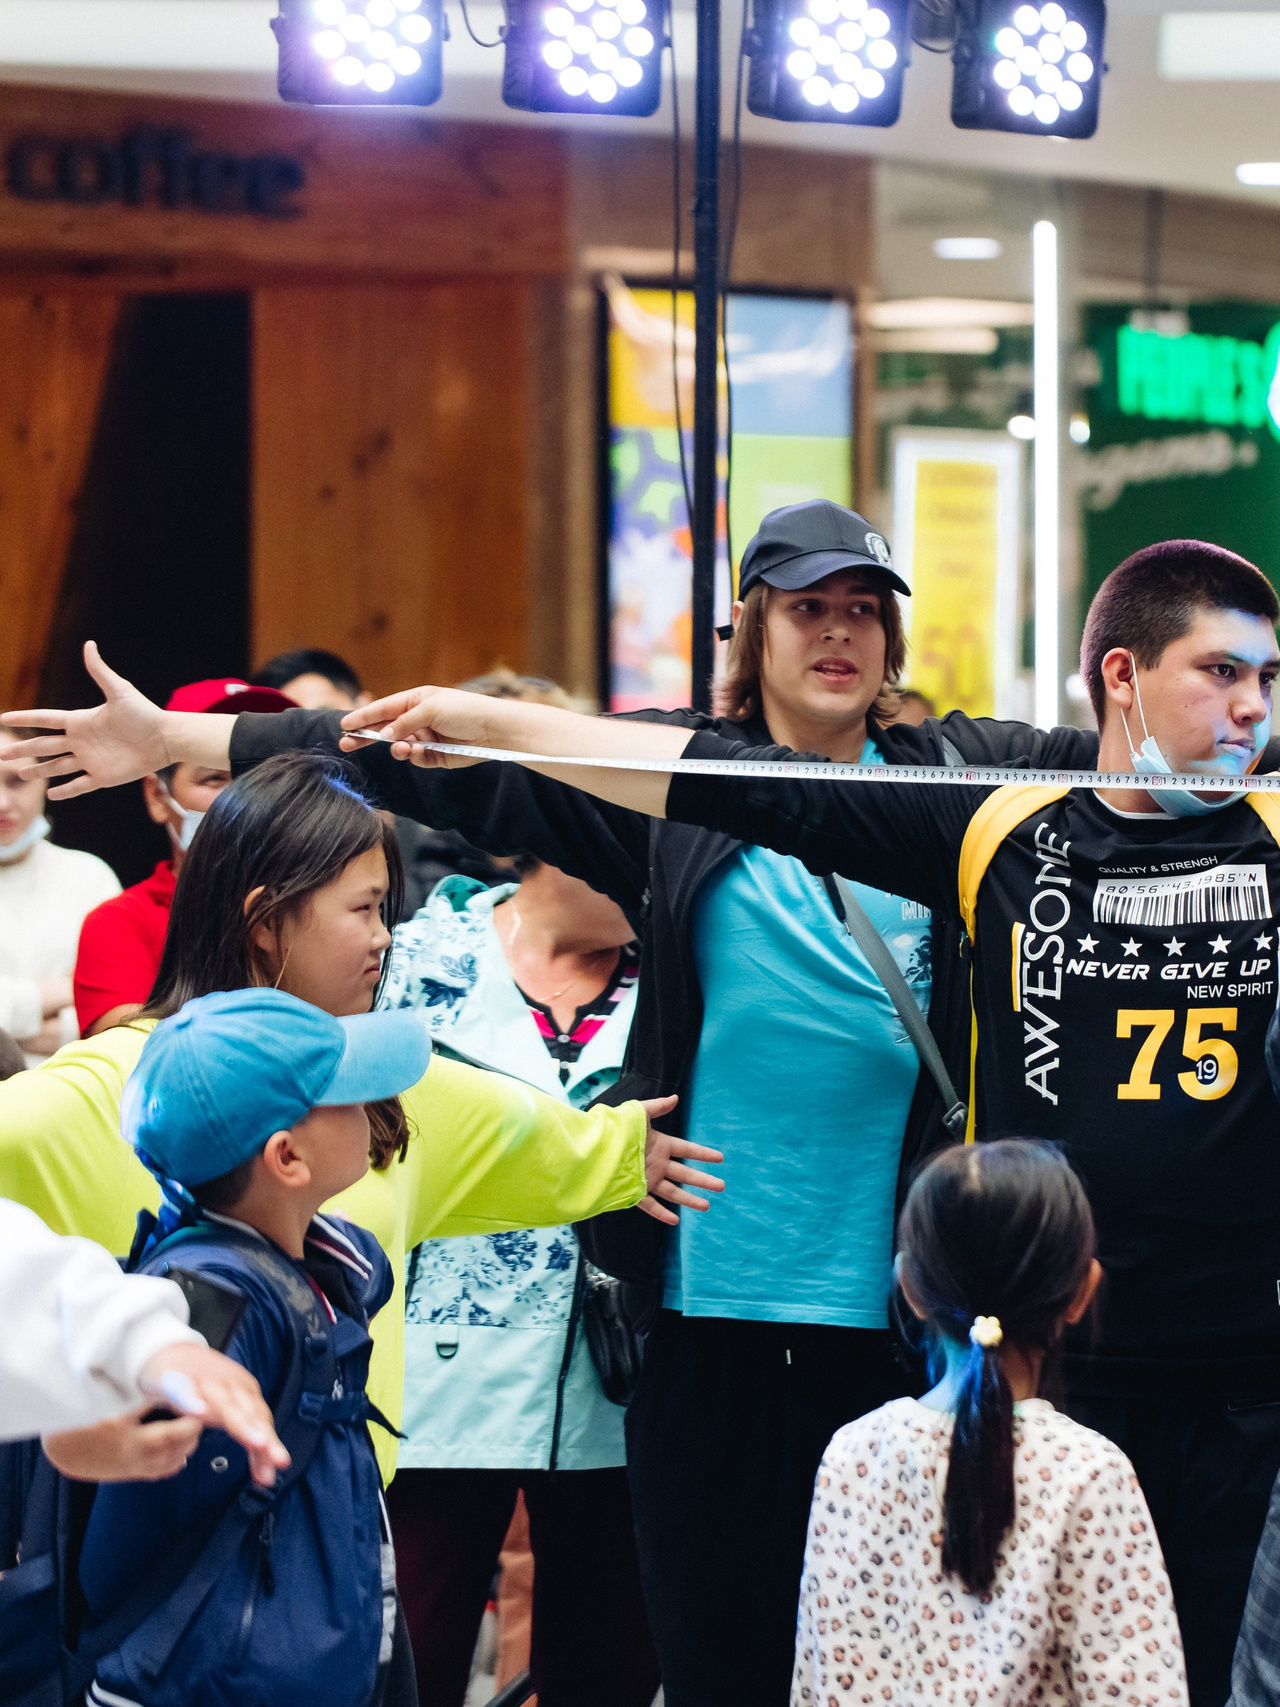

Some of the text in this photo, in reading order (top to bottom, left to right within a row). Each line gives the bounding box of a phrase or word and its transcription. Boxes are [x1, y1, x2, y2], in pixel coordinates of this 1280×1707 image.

[6, 121, 304, 220] coffee
[1098, 855, 1219, 875] QUALITY & STRENGH
[1065, 958, 1271, 981] NEVER GIVE UP
[1187, 981, 1274, 999] NEW SPIRIT
[1116, 1007, 1239, 1101] 75
[1196, 1059, 1217, 1080] 19
